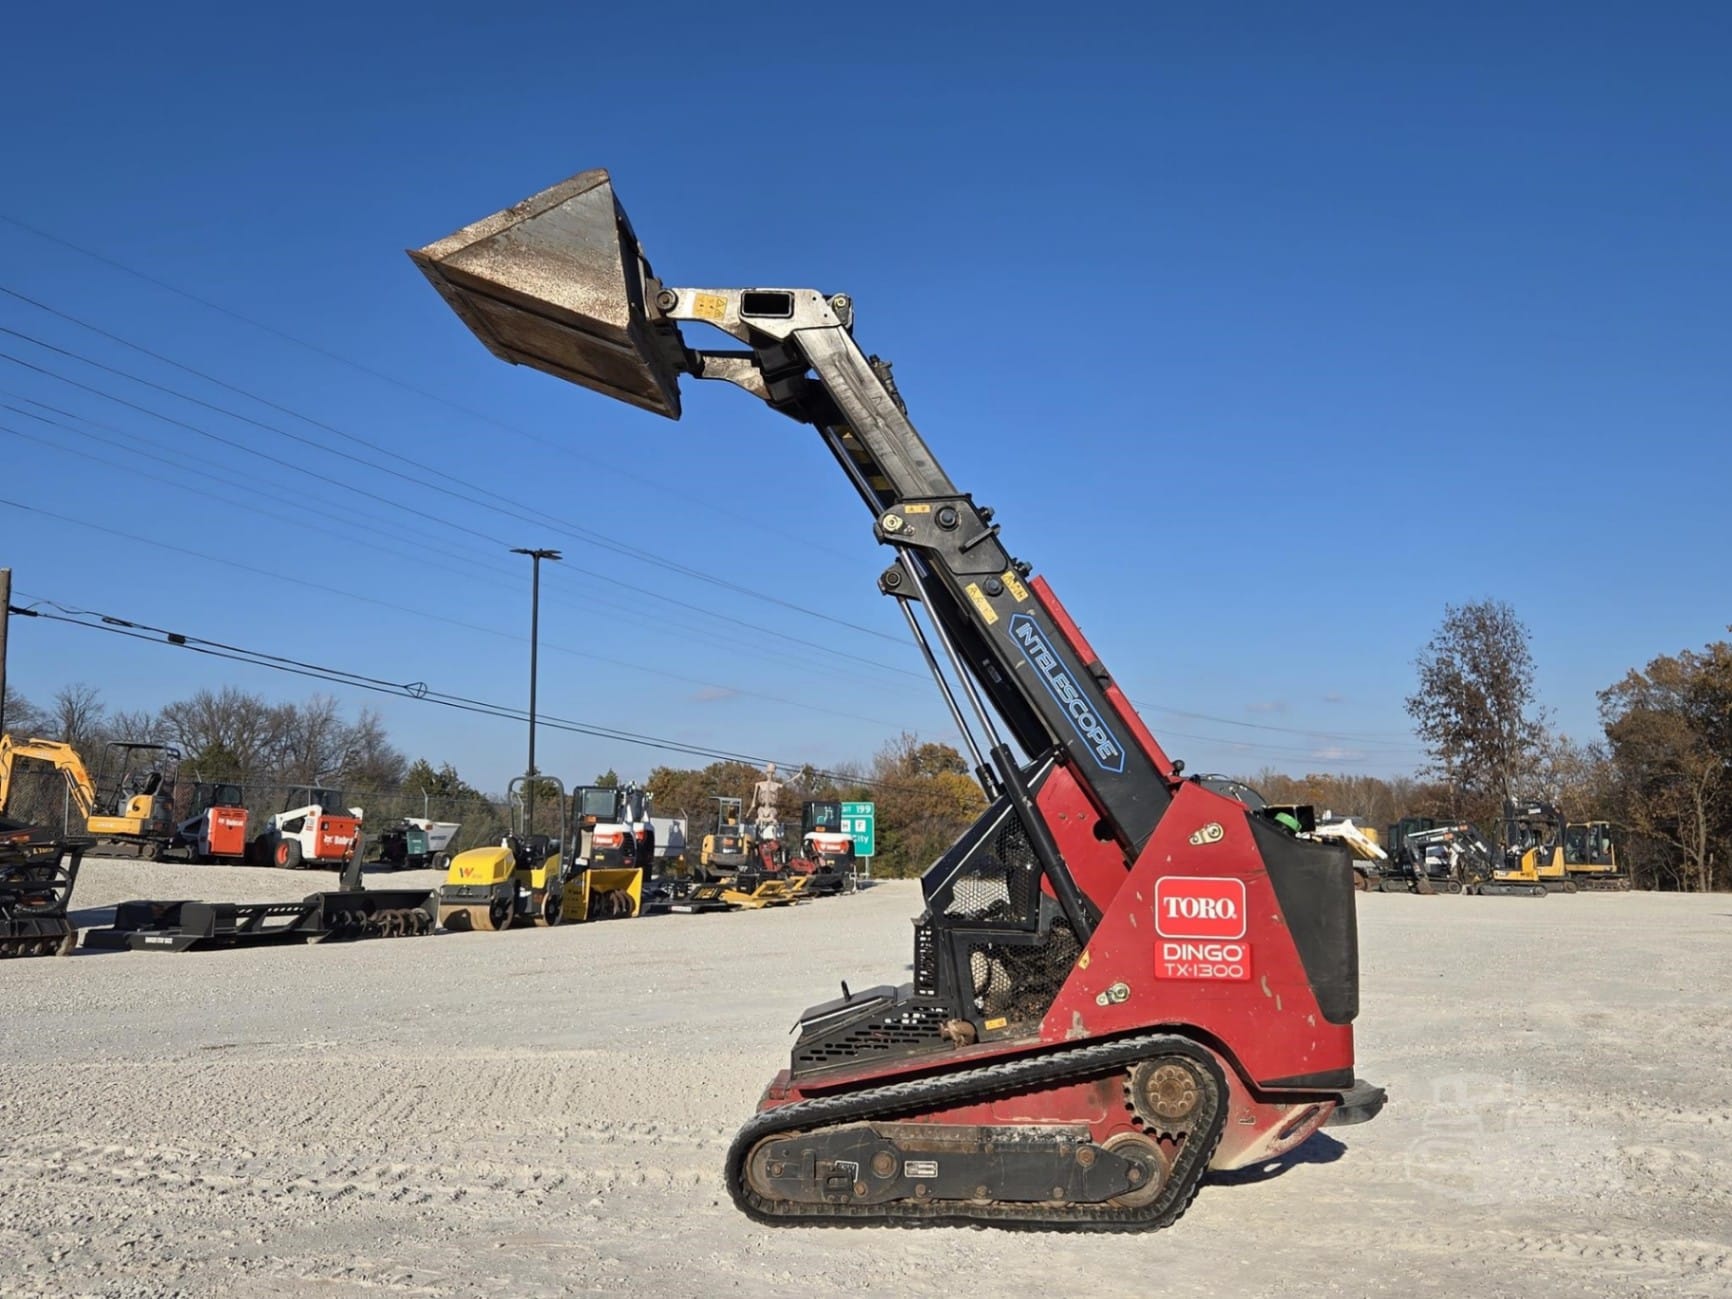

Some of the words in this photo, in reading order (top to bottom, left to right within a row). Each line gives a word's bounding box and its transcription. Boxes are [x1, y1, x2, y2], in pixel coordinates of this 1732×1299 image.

[1015, 622, 1119, 760] INTELESCOPE
[856, 804, 872, 814] 199
[1163, 896, 1237, 919] TORO
[1163, 943, 1244, 961] DINGO
